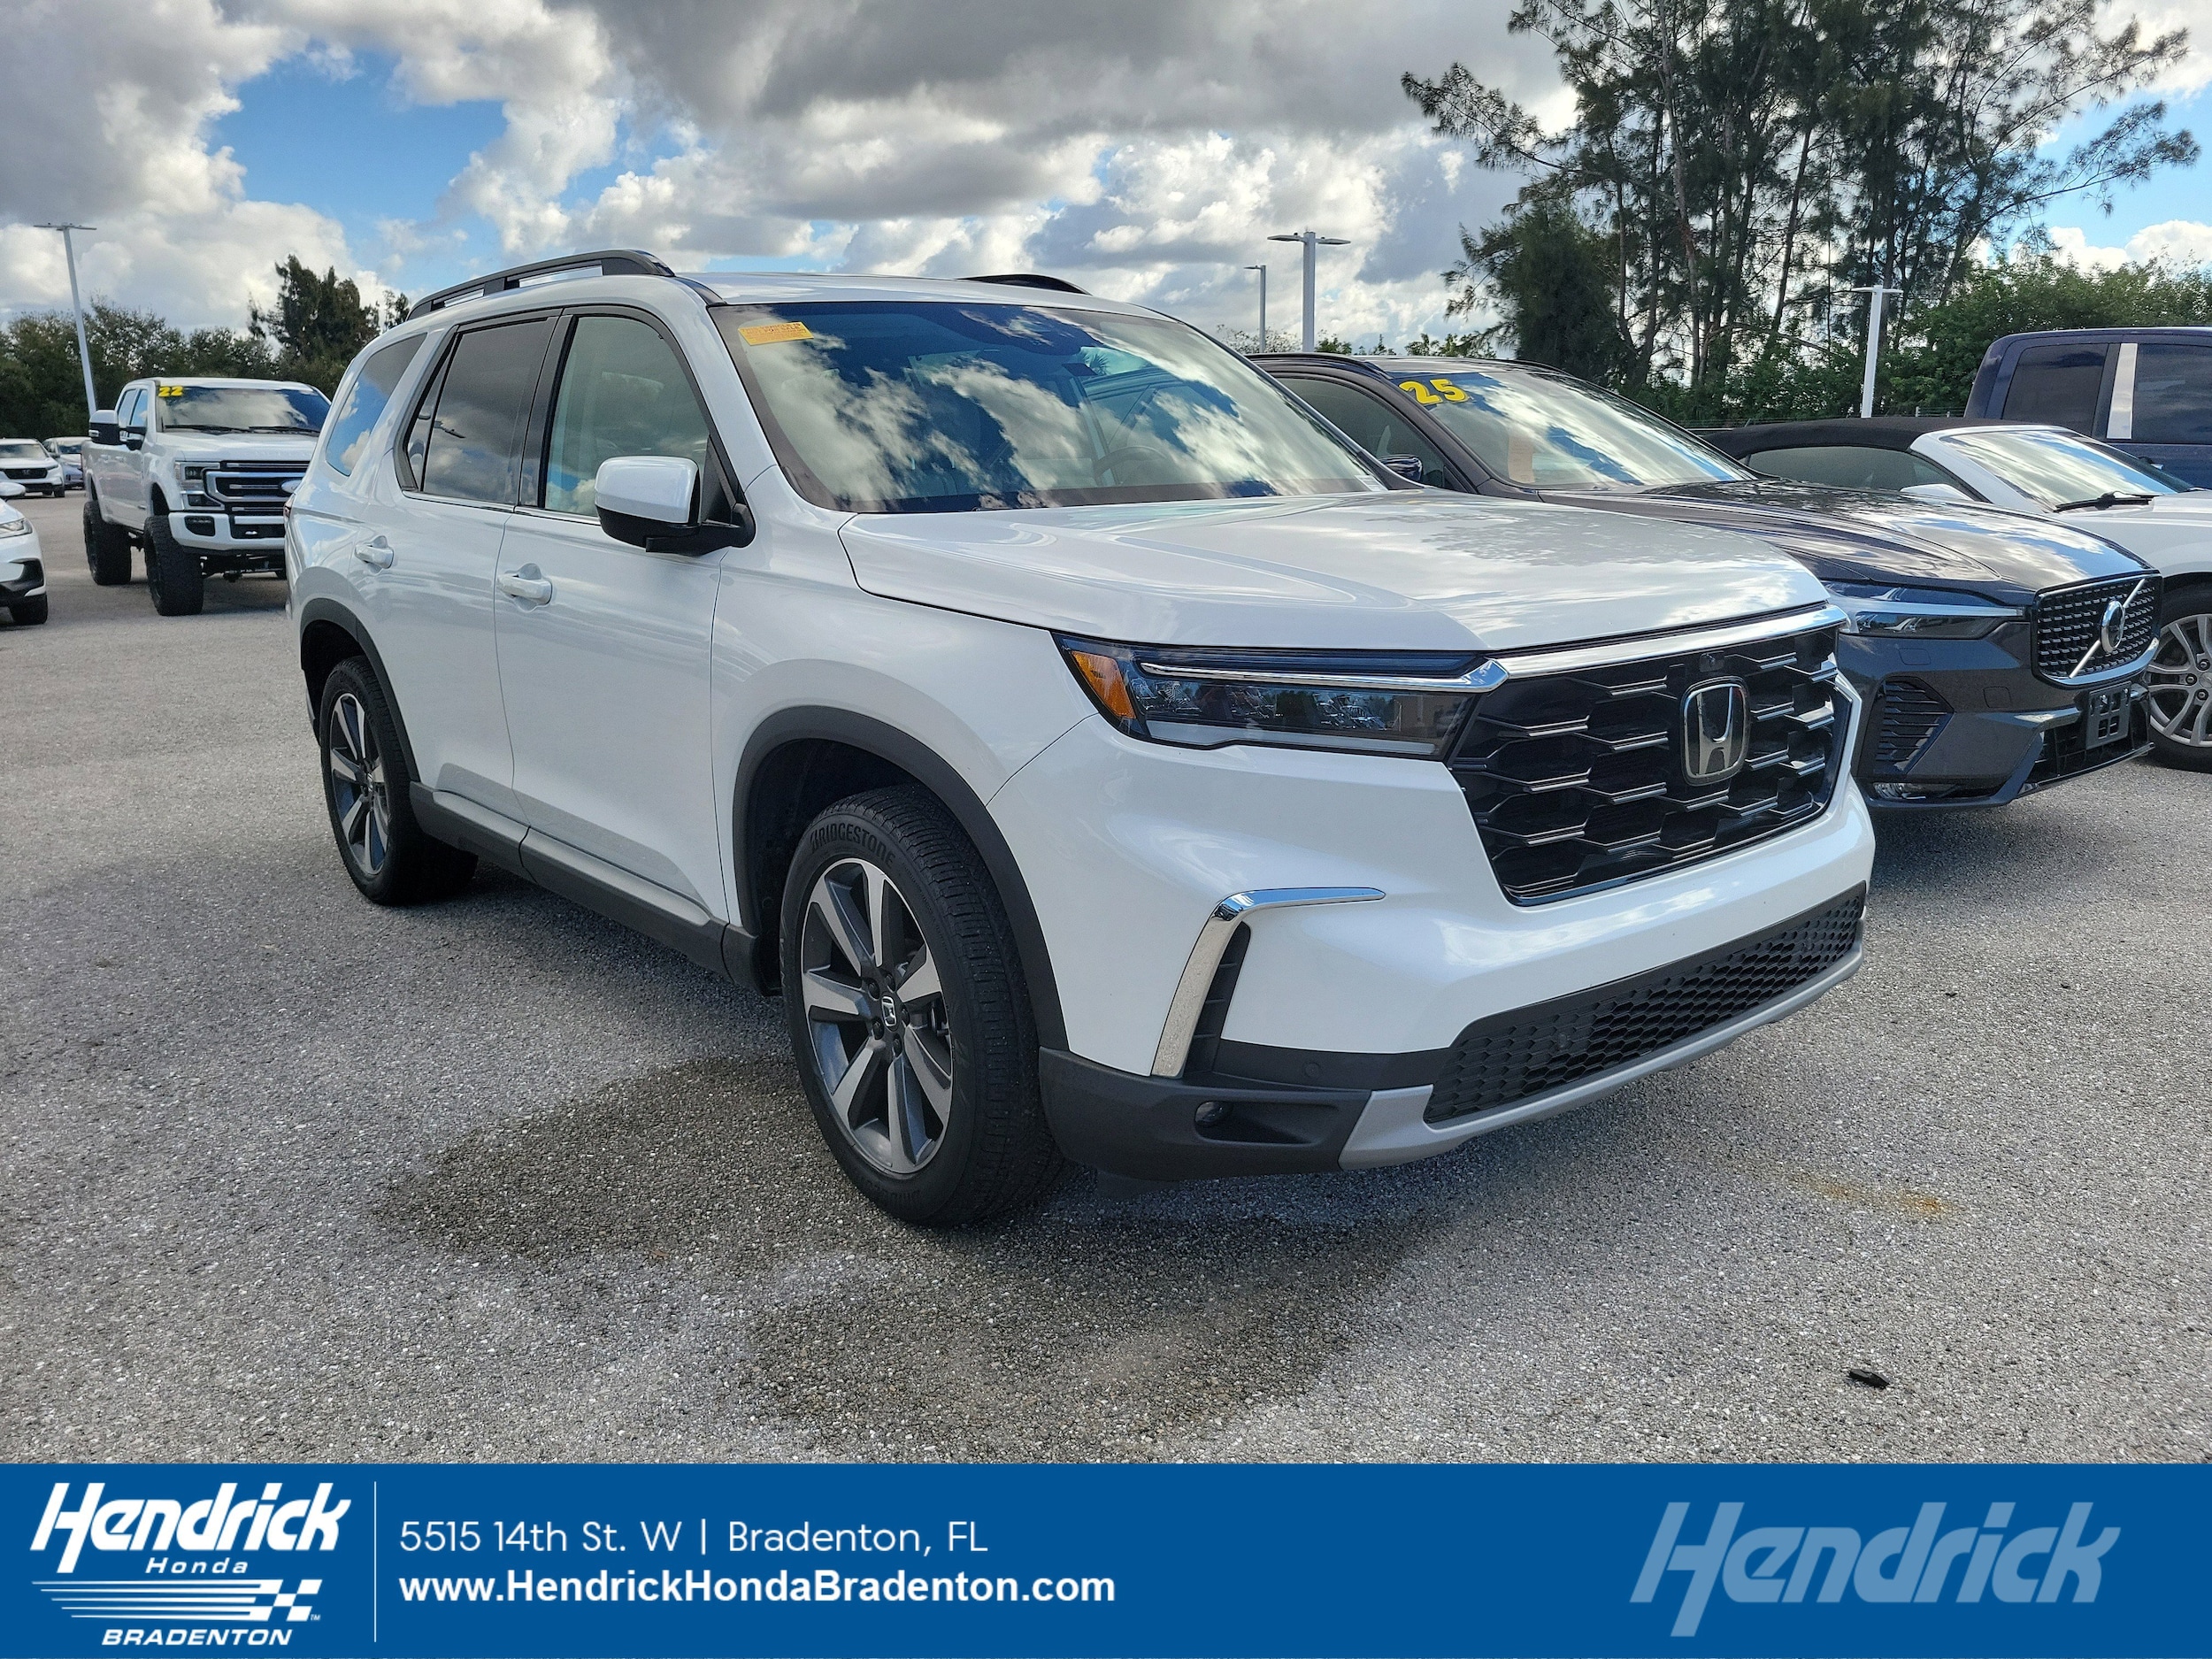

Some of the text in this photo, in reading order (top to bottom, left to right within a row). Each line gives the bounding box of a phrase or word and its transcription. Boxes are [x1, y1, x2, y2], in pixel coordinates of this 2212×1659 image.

[158, 386, 183, 396] 22
[1398, 378, 1468, 405] 25
[810, 823, 895, 868] BRIDGESTONE
